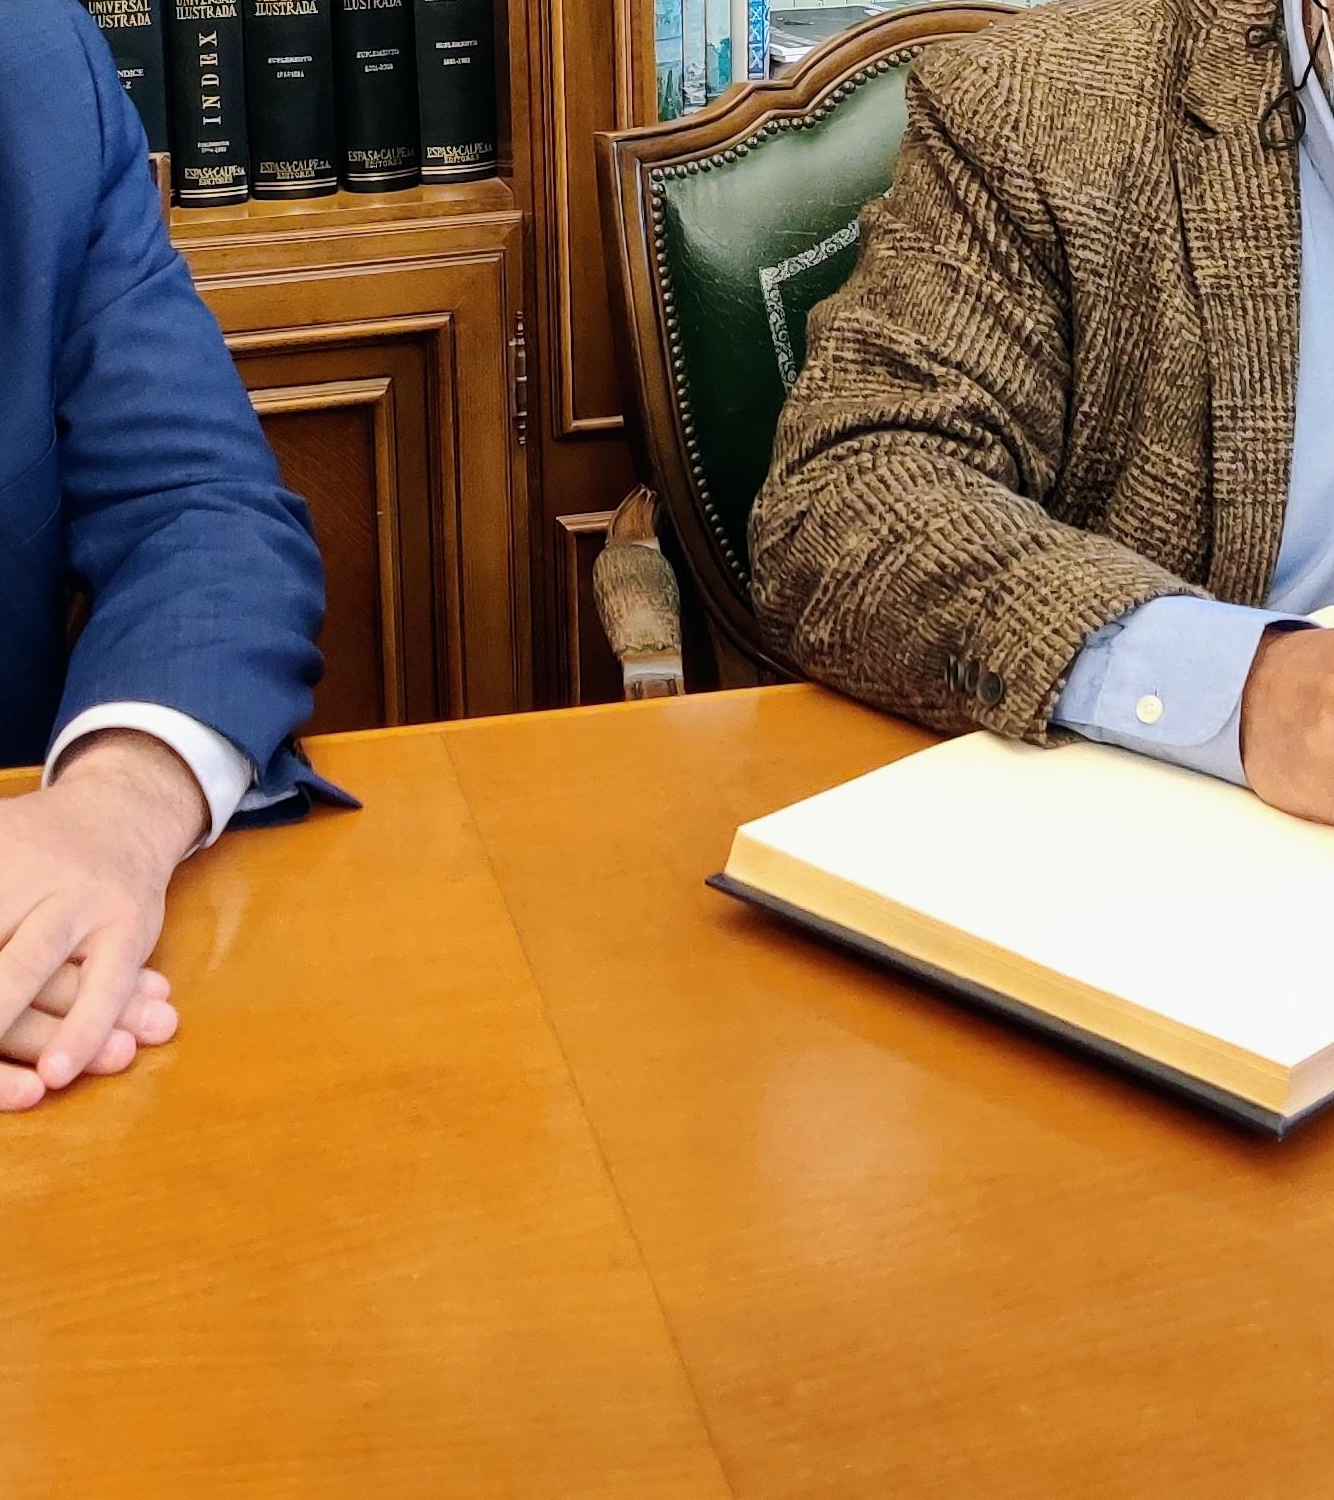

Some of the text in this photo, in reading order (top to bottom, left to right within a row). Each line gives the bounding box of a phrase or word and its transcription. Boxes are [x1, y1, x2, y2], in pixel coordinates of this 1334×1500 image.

[89, 0, 152, 15] UNIVERSAL
[176, 5, 238, 20] ILUSTRADA
[254, 0, 319, 16] ILUSTRADA
[198, 30, 223, 126] INDEX
[426, 142, 484, 159] ESPASA-CALPE
[259, 158, 319, 174] ESPASA-CALPE
